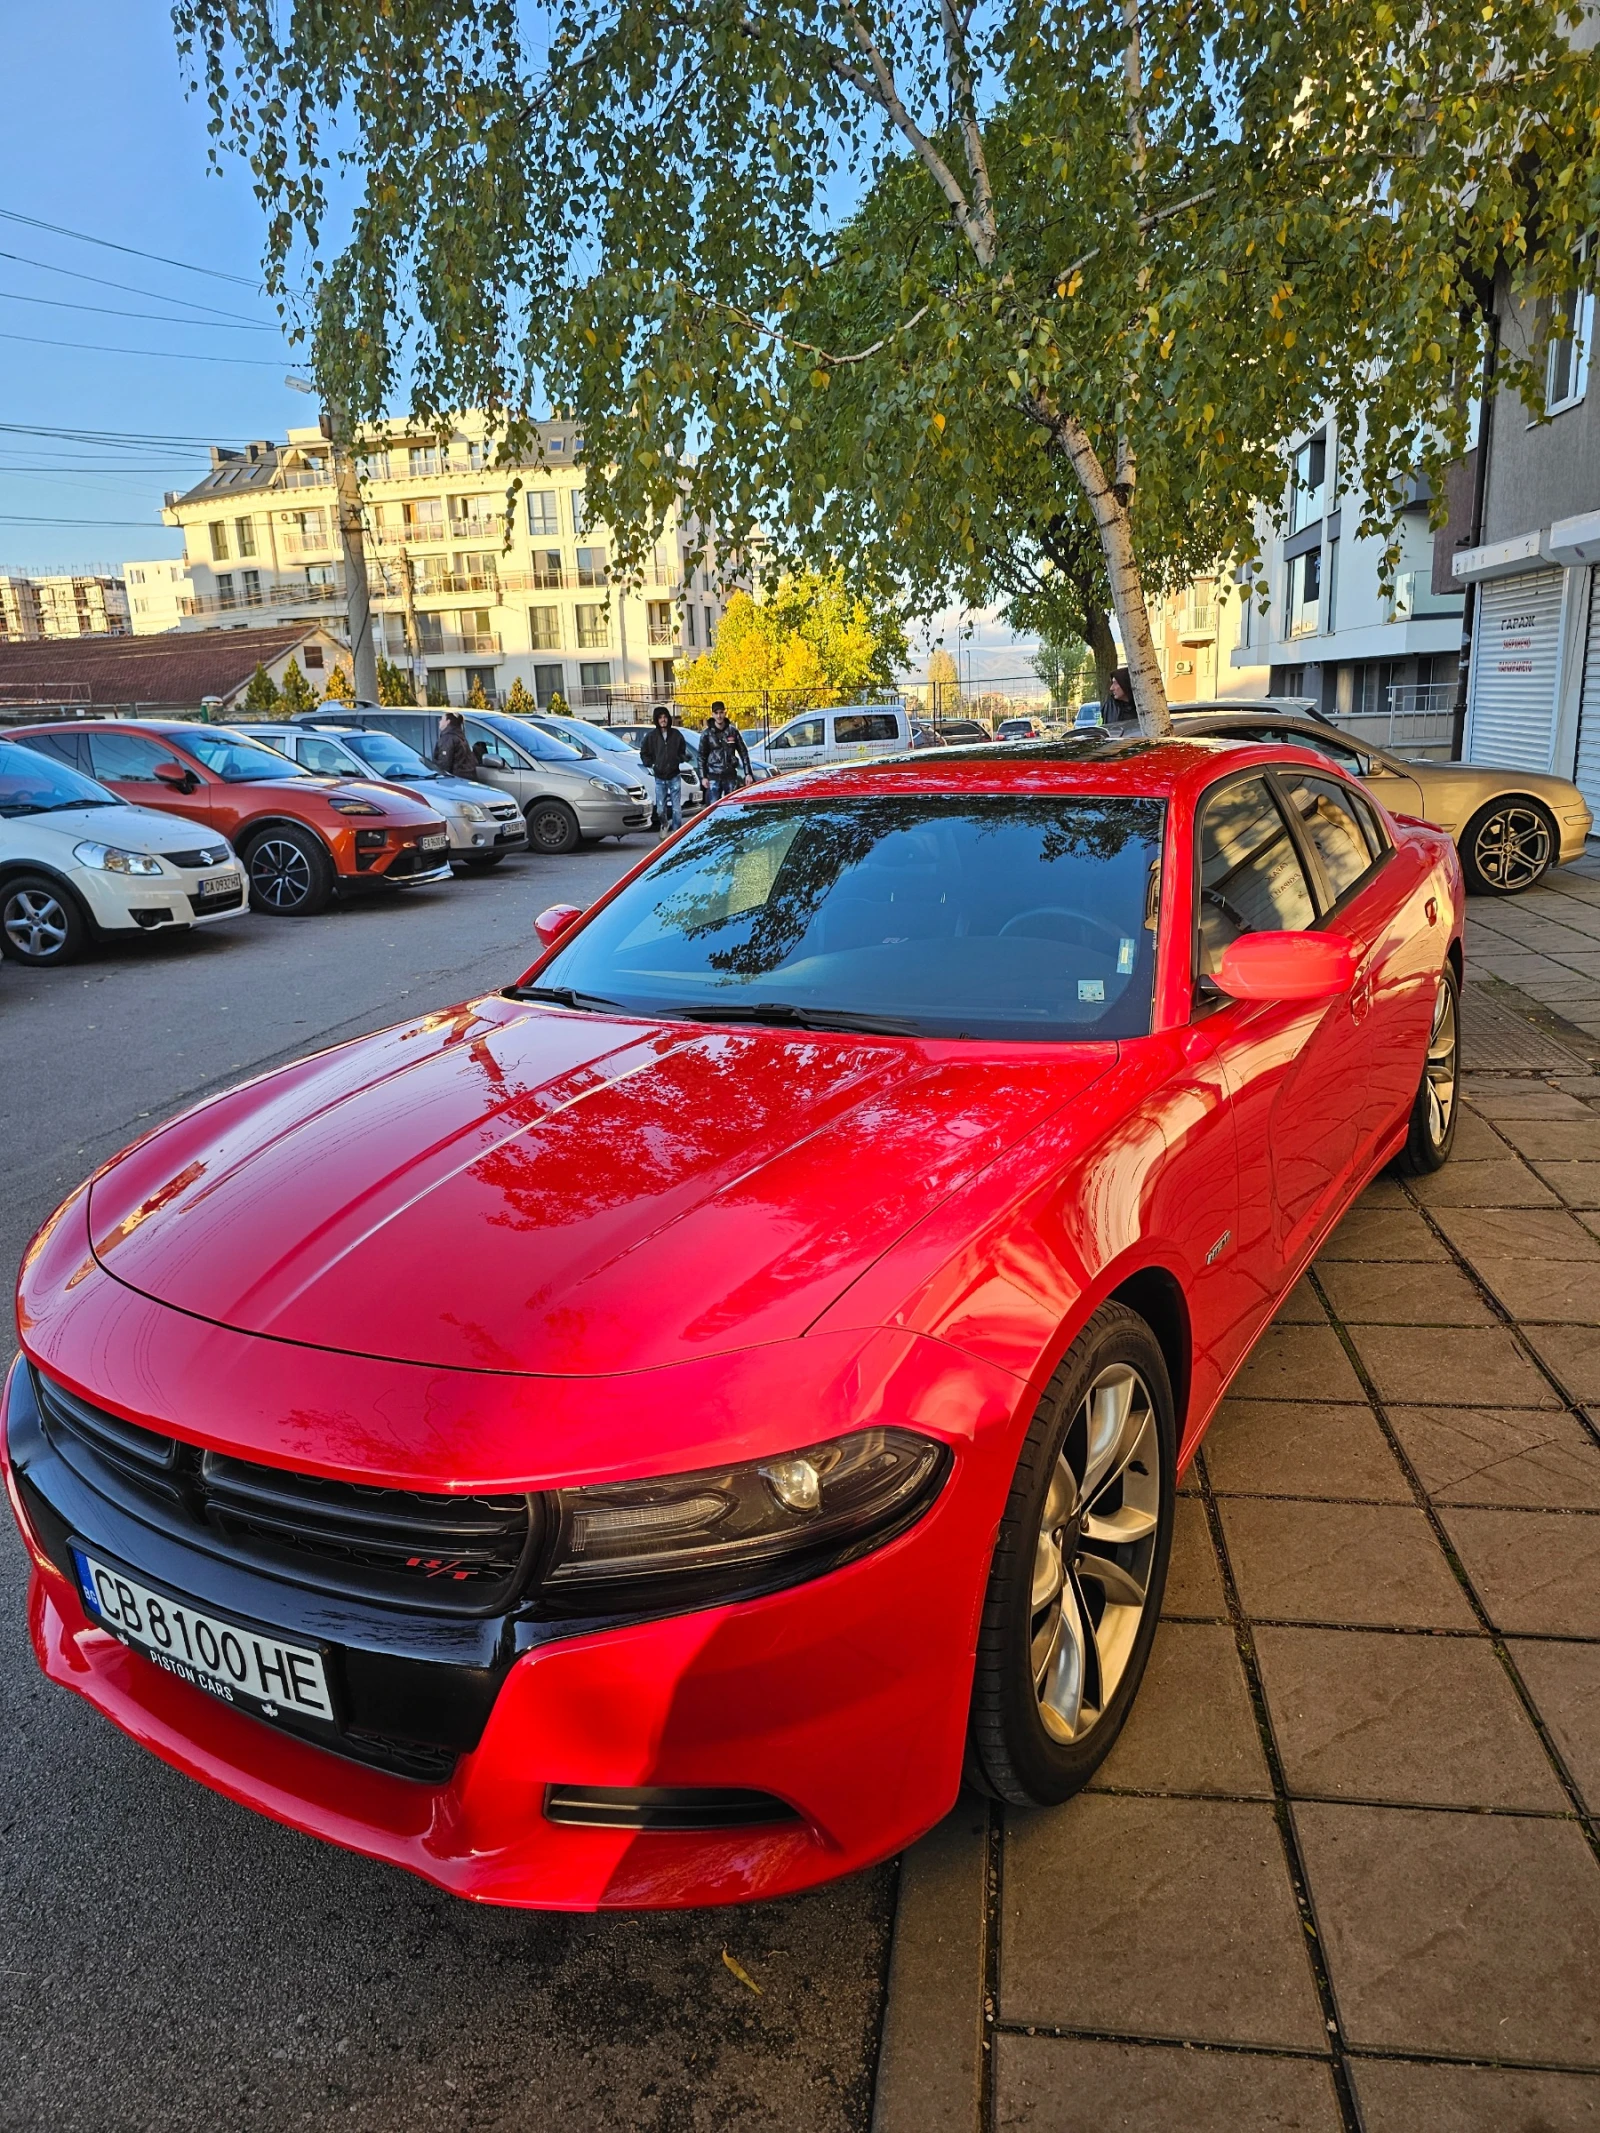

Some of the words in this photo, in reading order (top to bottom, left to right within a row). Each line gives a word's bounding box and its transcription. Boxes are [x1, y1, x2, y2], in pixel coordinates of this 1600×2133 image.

[1501, 615, 1535, 630] ГАРАЖ
[205, 881, 215, 894] CA
[216, 879, 230, 891] 0932
[406, 1557, 478, 1580] R/T
[83, 1585, 98, 1605] BG
[94, 1568, 143, 1633] CB
[146, 1598, 247, 1682] 8100
[253, 1641, 325, 1711] HE
[150, 1650, 195, 1684] PISTON
[198, 1674, 234, 1702] CARS
